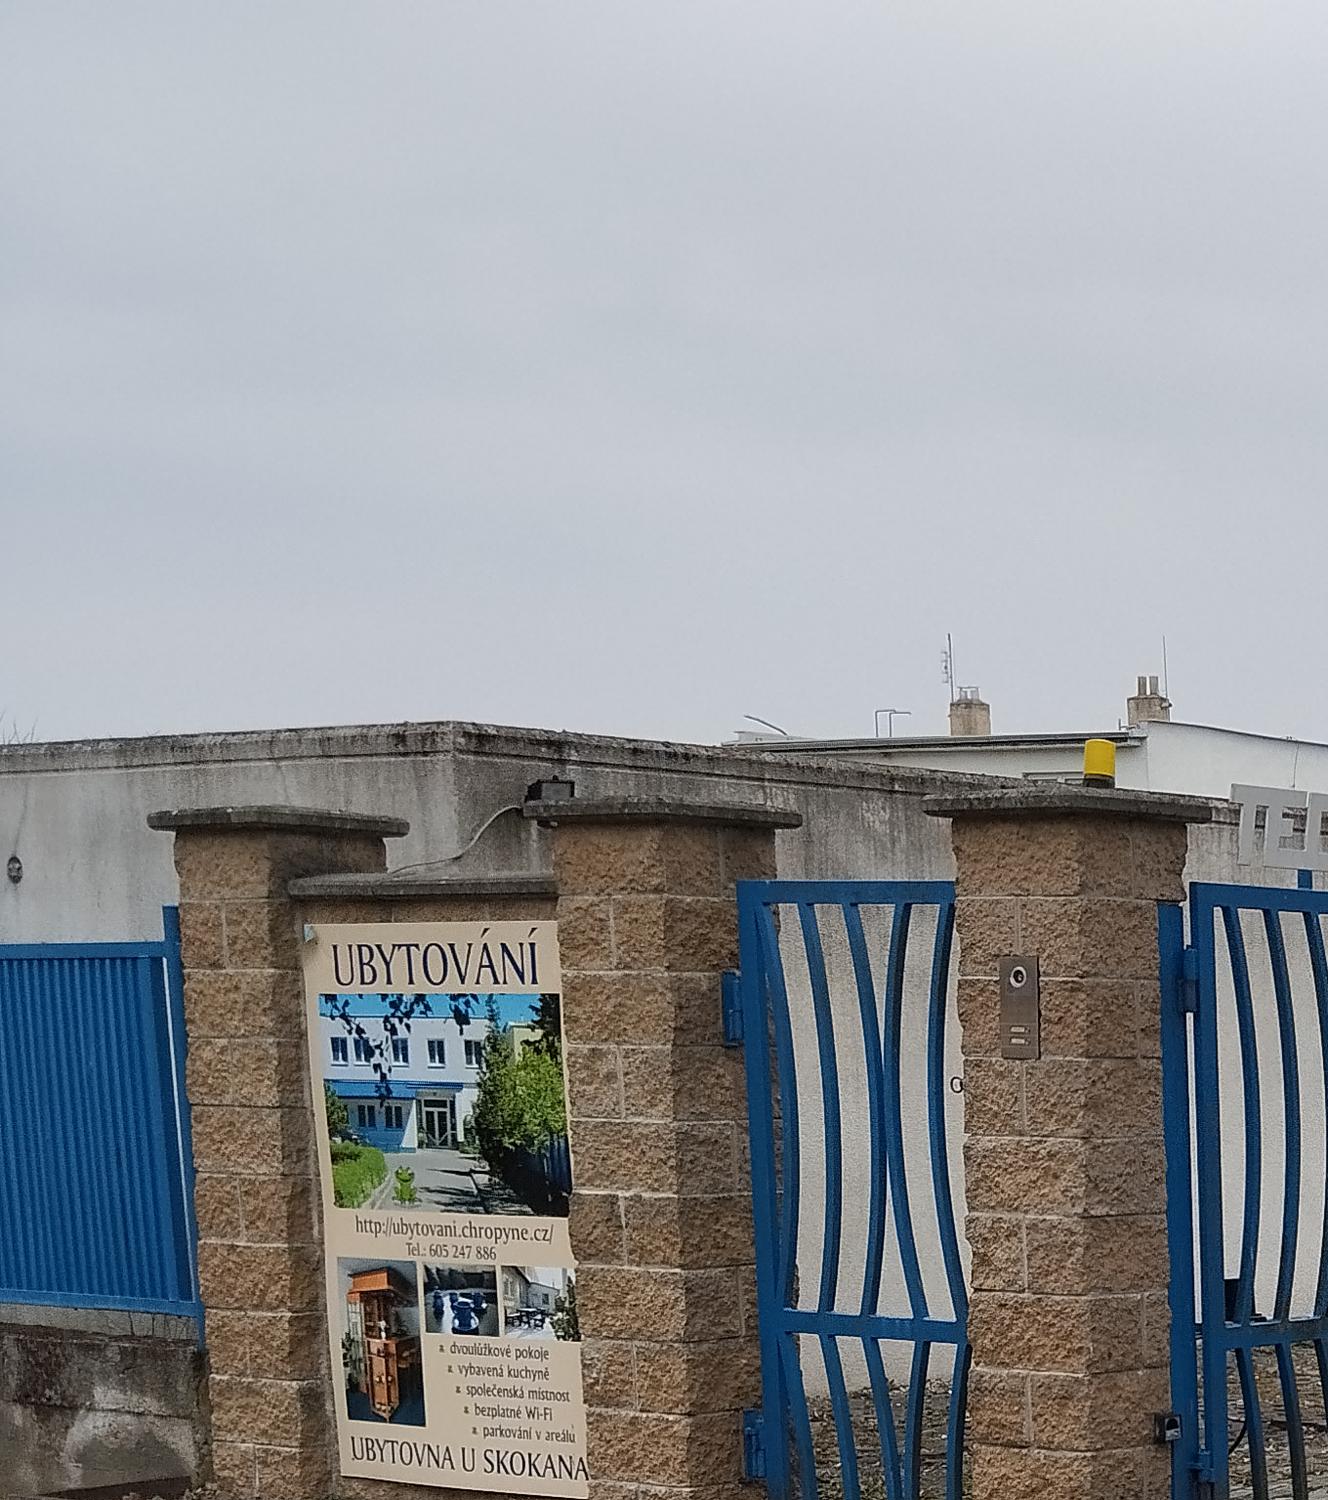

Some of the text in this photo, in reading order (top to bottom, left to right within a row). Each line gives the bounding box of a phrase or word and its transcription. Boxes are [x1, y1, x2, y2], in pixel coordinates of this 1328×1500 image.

[332, 927, 539, 986] UBYTOVÁNÍ
[355, 1214, 554, 1245] http://ubytovani.chropyne.cz/
[405, 1242, 497, 1261] Tel.: 605 247 886
[514, 1344, 550, 1362] pokoje
[457, 1362, 550, 1382] vybavená kuchyně
[465, 1383, 570, 1402] společenská místnost
[473, 1403, 553, 1421] bezplatné Wi-Fi
[482, 1424, 532, 1440] parkování
[535, 1430, 542, 1440] v
[350, 1436, 590, 1481] UBYTOVNA U SKOKANA
